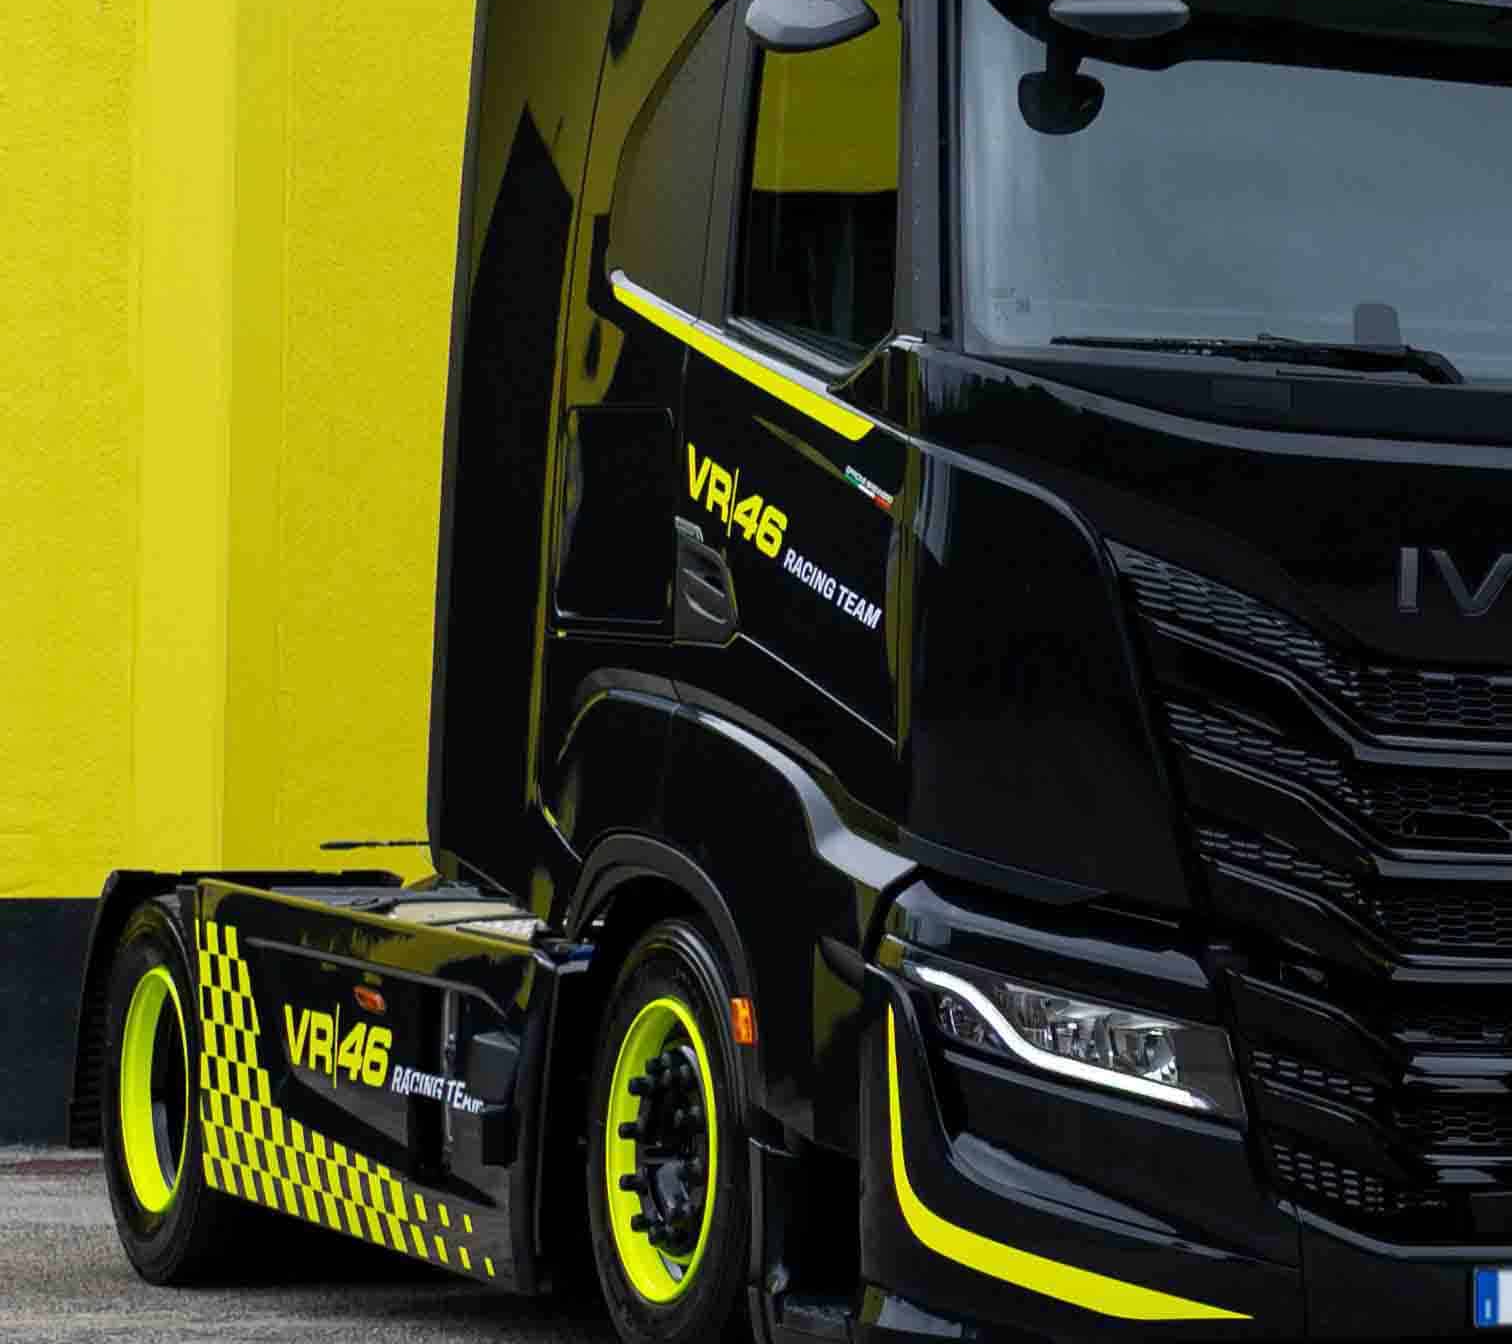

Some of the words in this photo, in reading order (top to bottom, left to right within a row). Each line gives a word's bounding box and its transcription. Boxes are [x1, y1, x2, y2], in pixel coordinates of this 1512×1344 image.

[783, 548, 836, 600] RACING
[836, 585, 882, 629] TEAM
[391, 1065, 445, 1100] RACING
